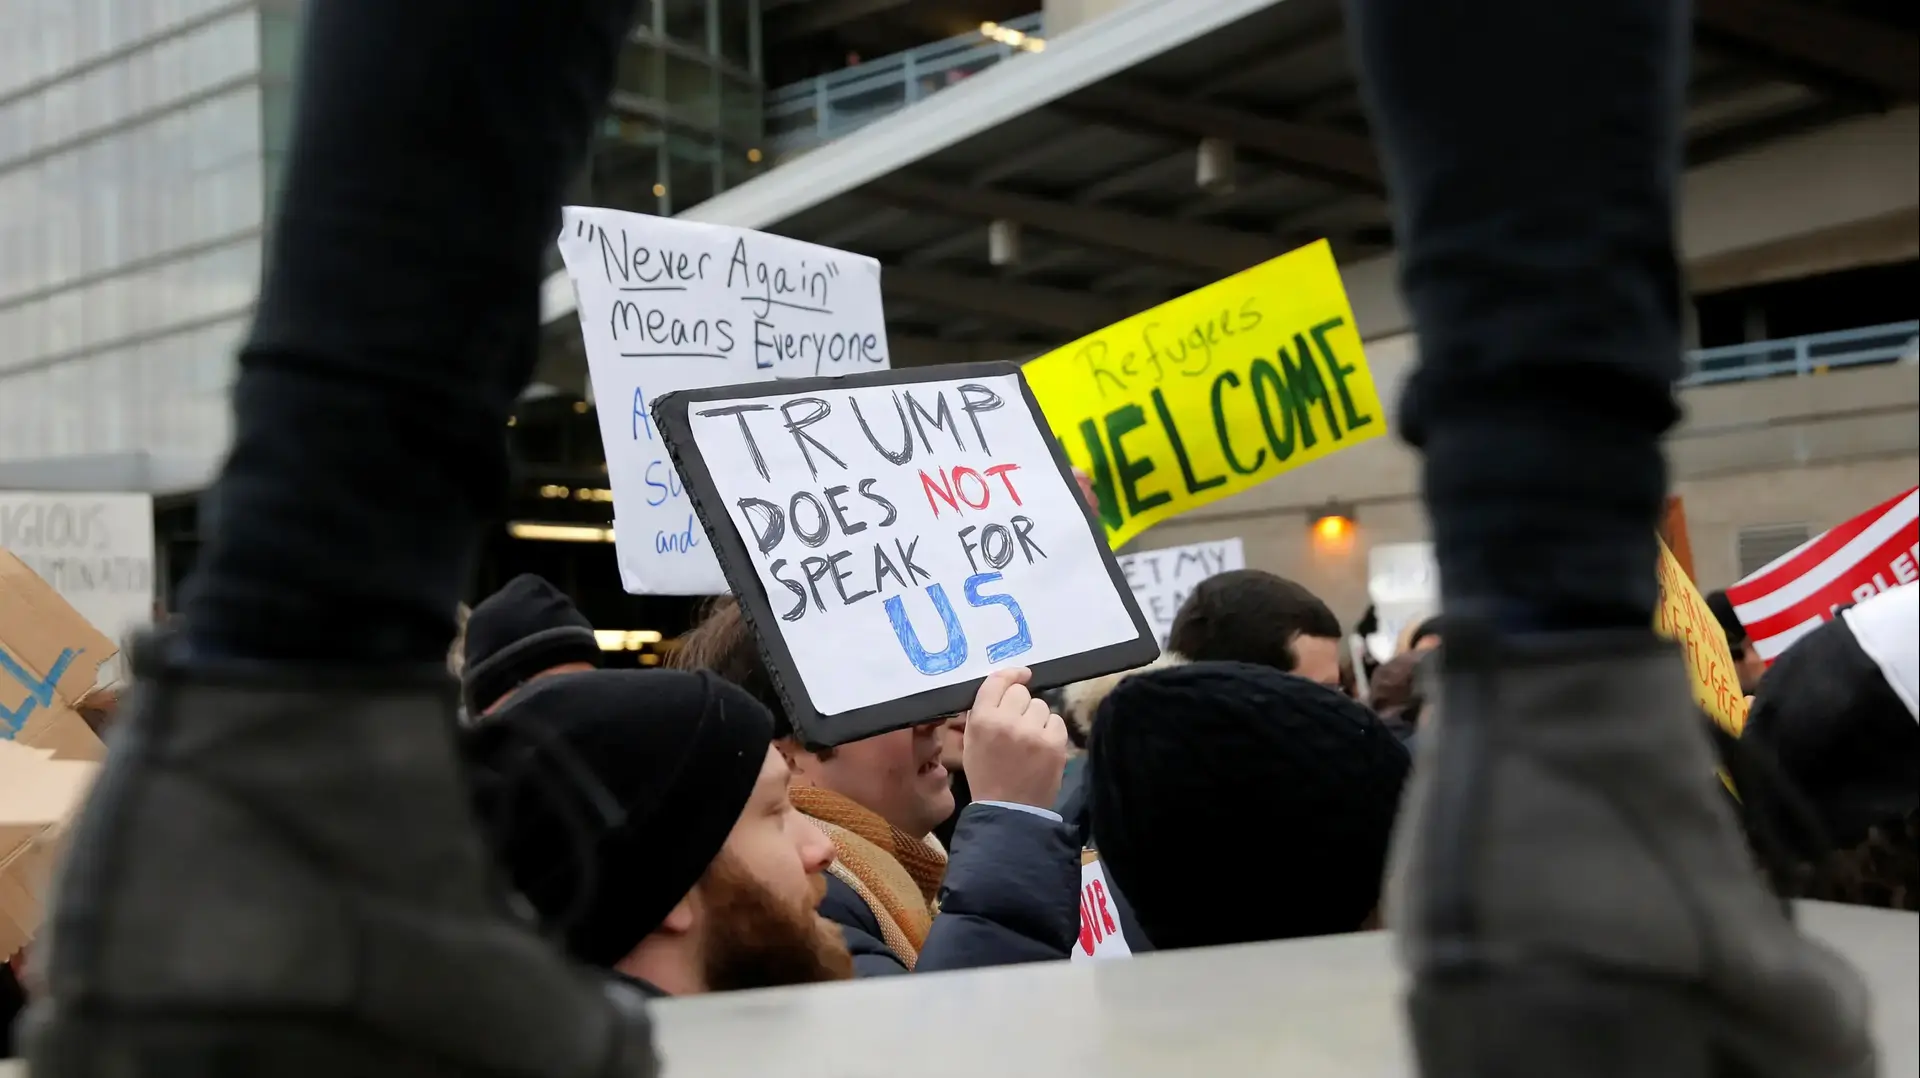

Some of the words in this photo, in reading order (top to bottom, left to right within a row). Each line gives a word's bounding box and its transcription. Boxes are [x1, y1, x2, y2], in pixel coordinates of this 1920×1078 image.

[577, 220, 712, 284] "Never
[727, 236, 839, 319] Again"
[754, 319, 884, 375] Everyone
[1074, 297, 1263, 398] Refugees
[695, 384, 1005, 483] TRUMP
[656, 514, 699, 554] and
[737, 479, 897, 558] DOES
[918, 464, 1021, 519] NOT
[770, 535, 931, 622] SPEAK
[958, 515, 1047, 575] FOR
[882, 571, 1033, 676] US
